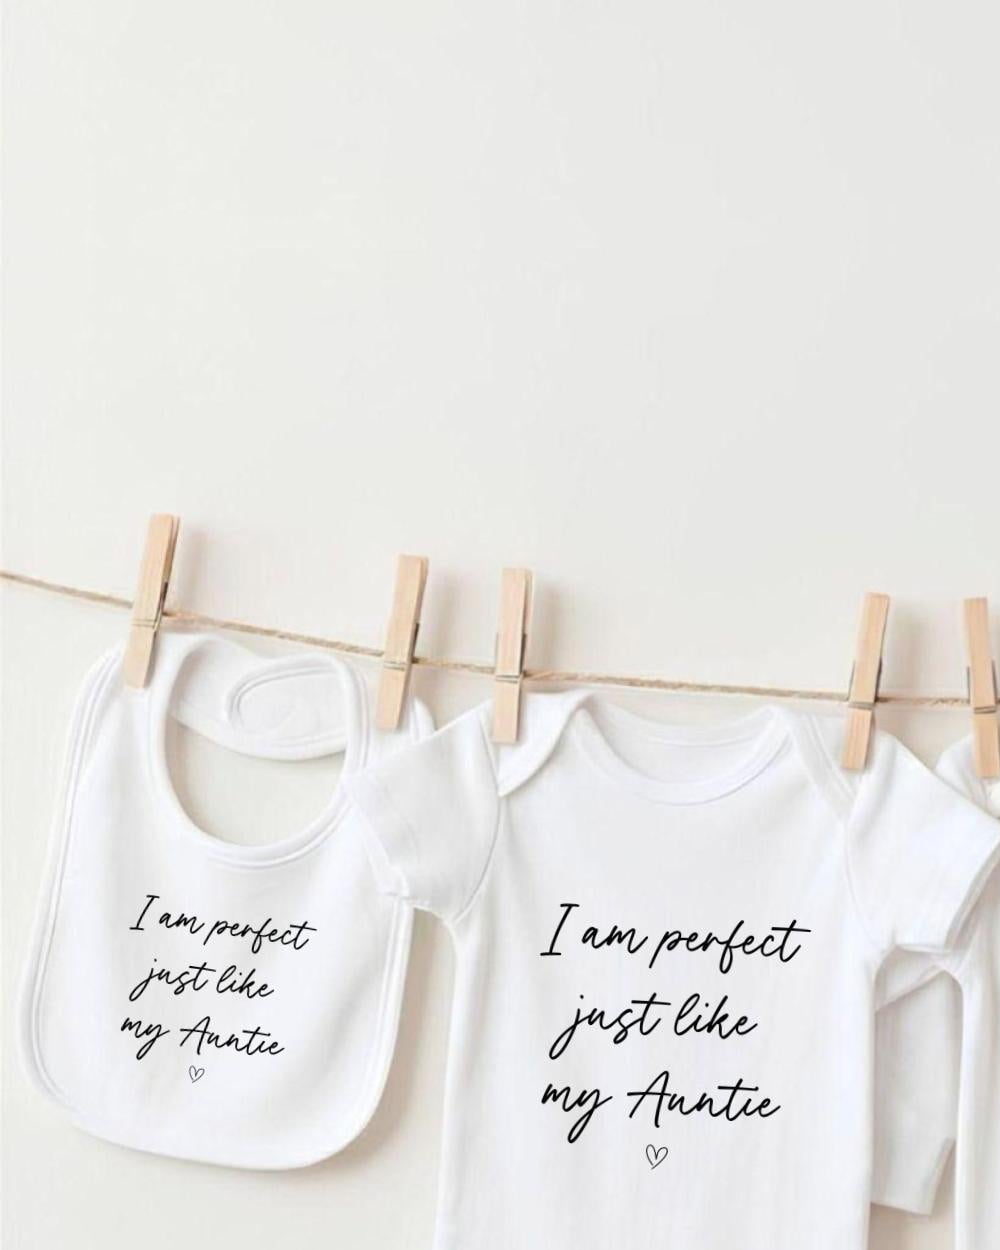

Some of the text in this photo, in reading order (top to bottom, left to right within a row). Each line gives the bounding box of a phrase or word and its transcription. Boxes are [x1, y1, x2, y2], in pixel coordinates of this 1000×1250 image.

[129, 894, 317, 955] I am perfect
[539, 903, 812, 975] I am perfect
[128, 958, 275, 1002] just like
[120, 1015, 285, 1061] my Auntie
[548, 992, 758, 1061] just like
[541, 1070, 781, 1144] my Auntie
